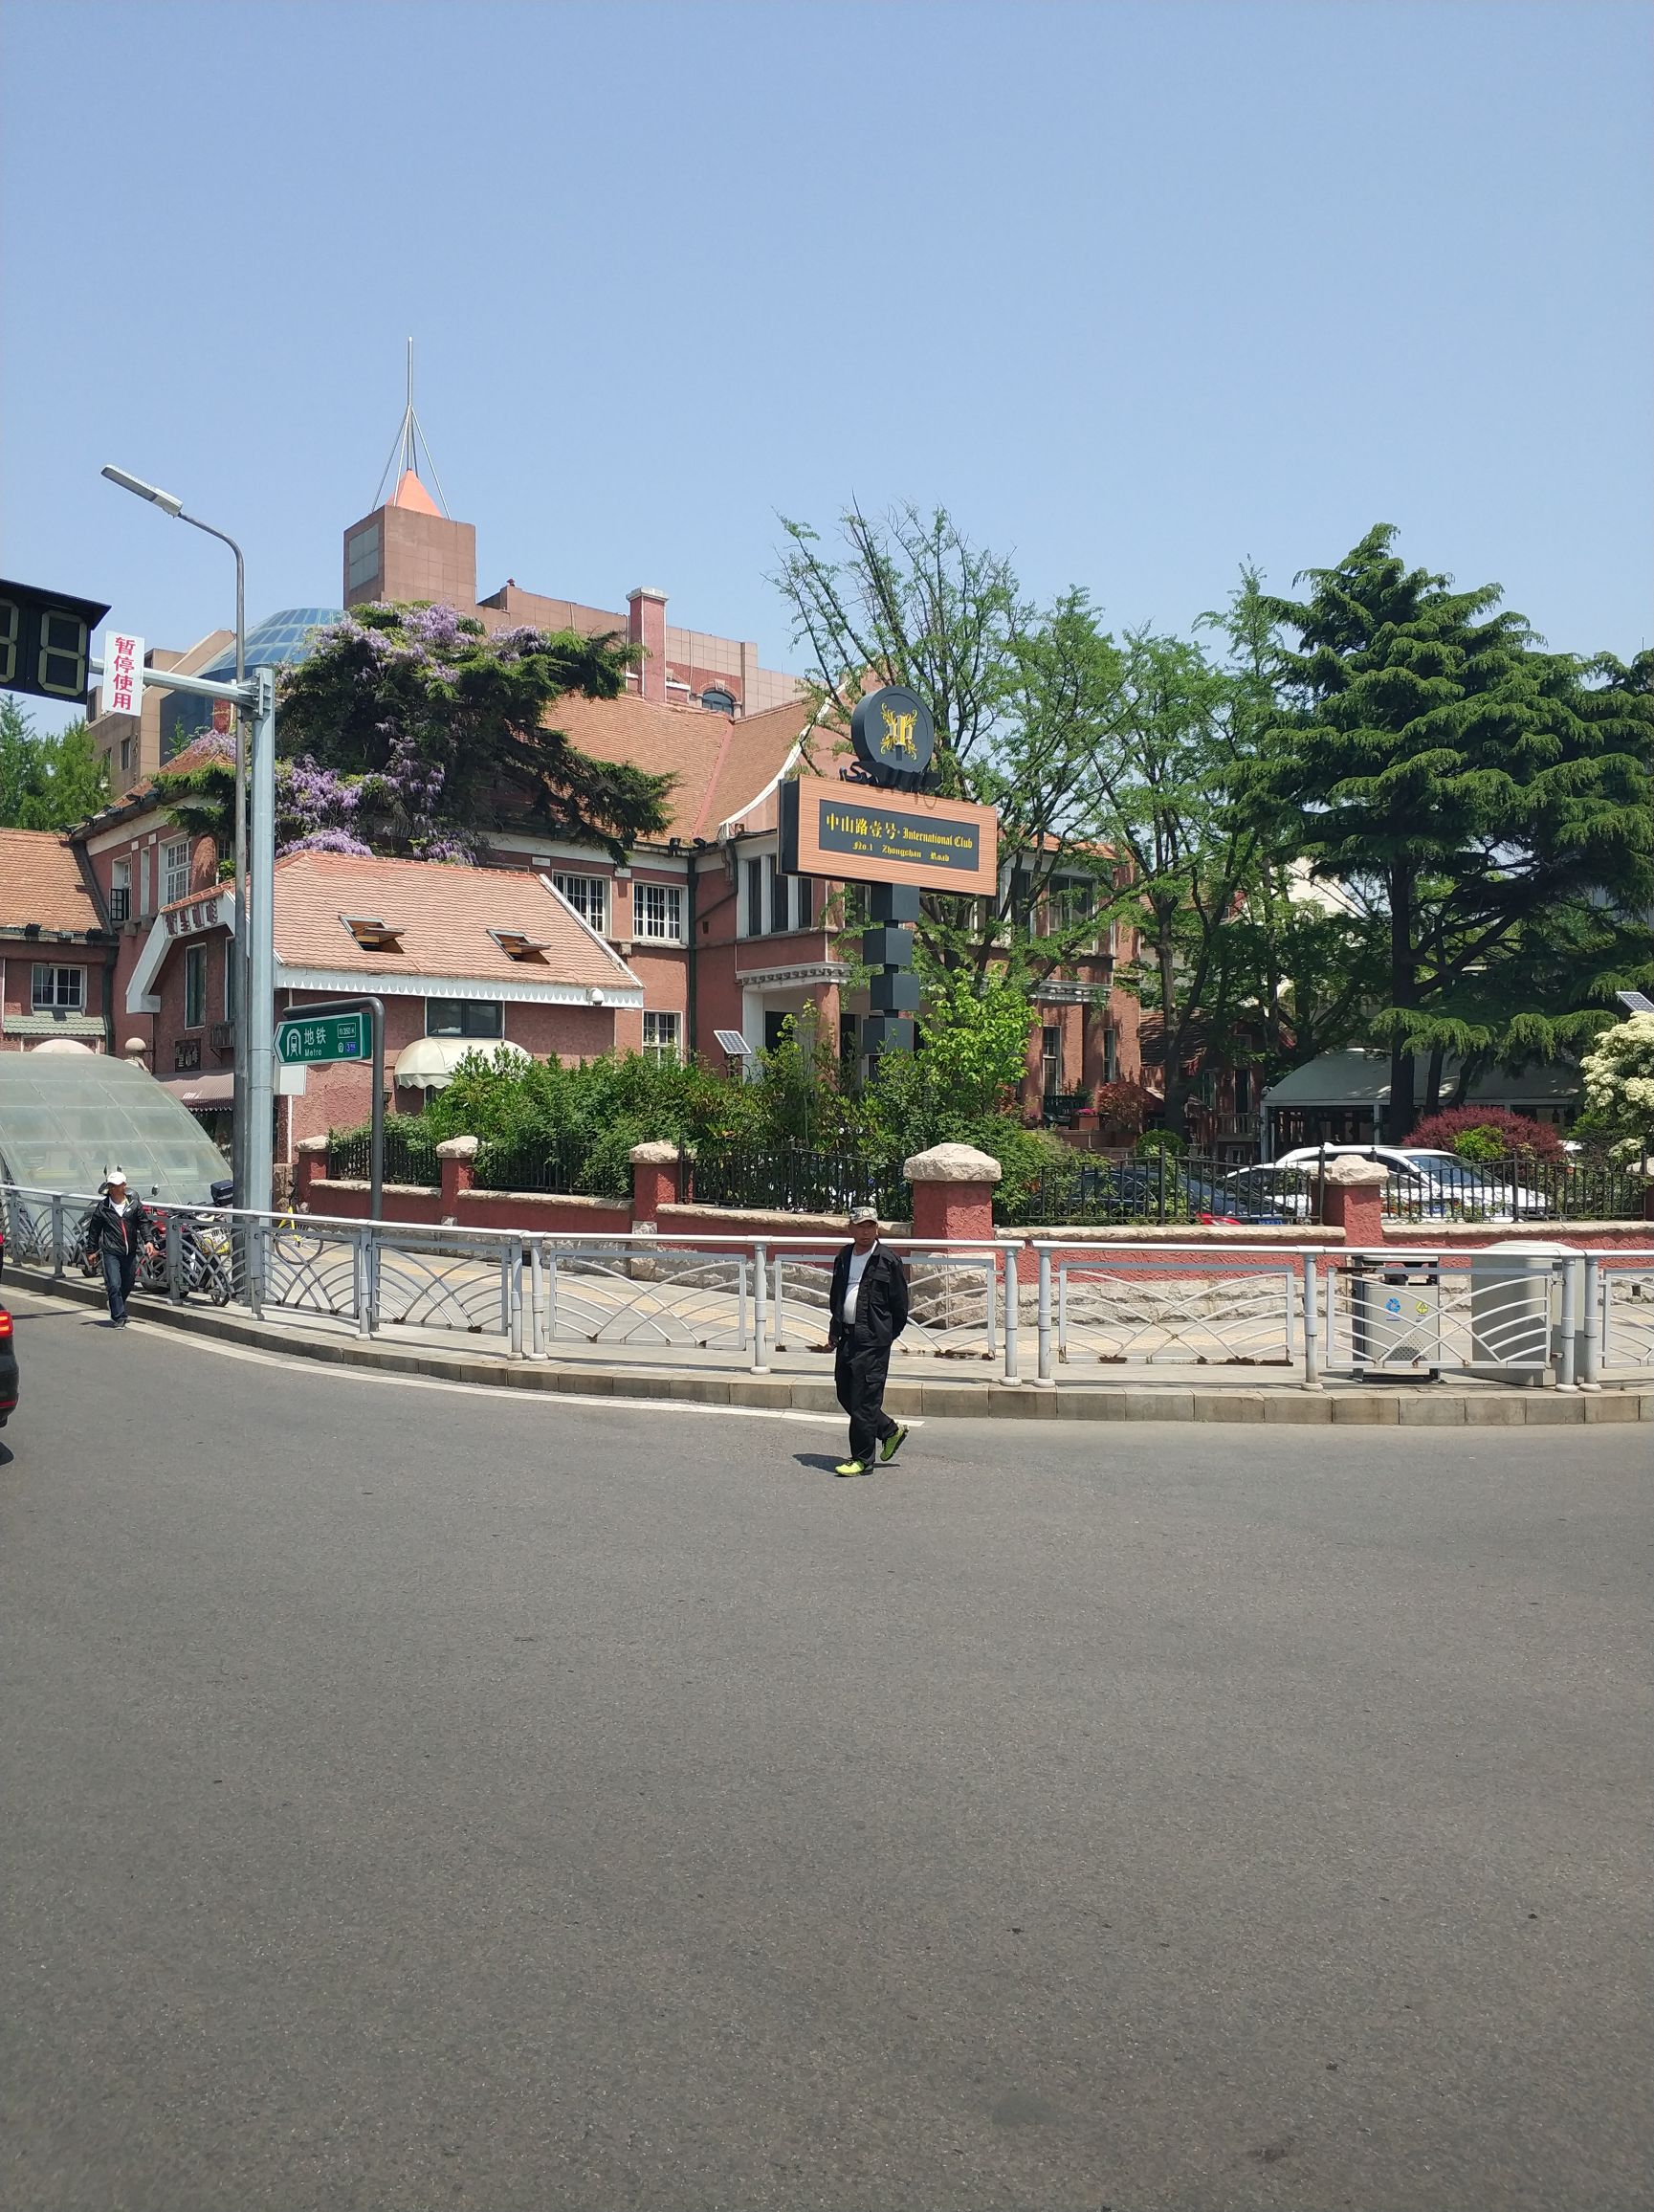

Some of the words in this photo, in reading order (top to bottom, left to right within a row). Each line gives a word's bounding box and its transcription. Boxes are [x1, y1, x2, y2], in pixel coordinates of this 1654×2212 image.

[112, 636, 136, 711] 暂停使用
[902, 827, 953, 847] International
[954, 836, 973, 851] Club
[881, 844, 922, 858] Zhongshan
[930, 852, 950, 862] Road
[304, 1027, 326, 1045] 地铁
